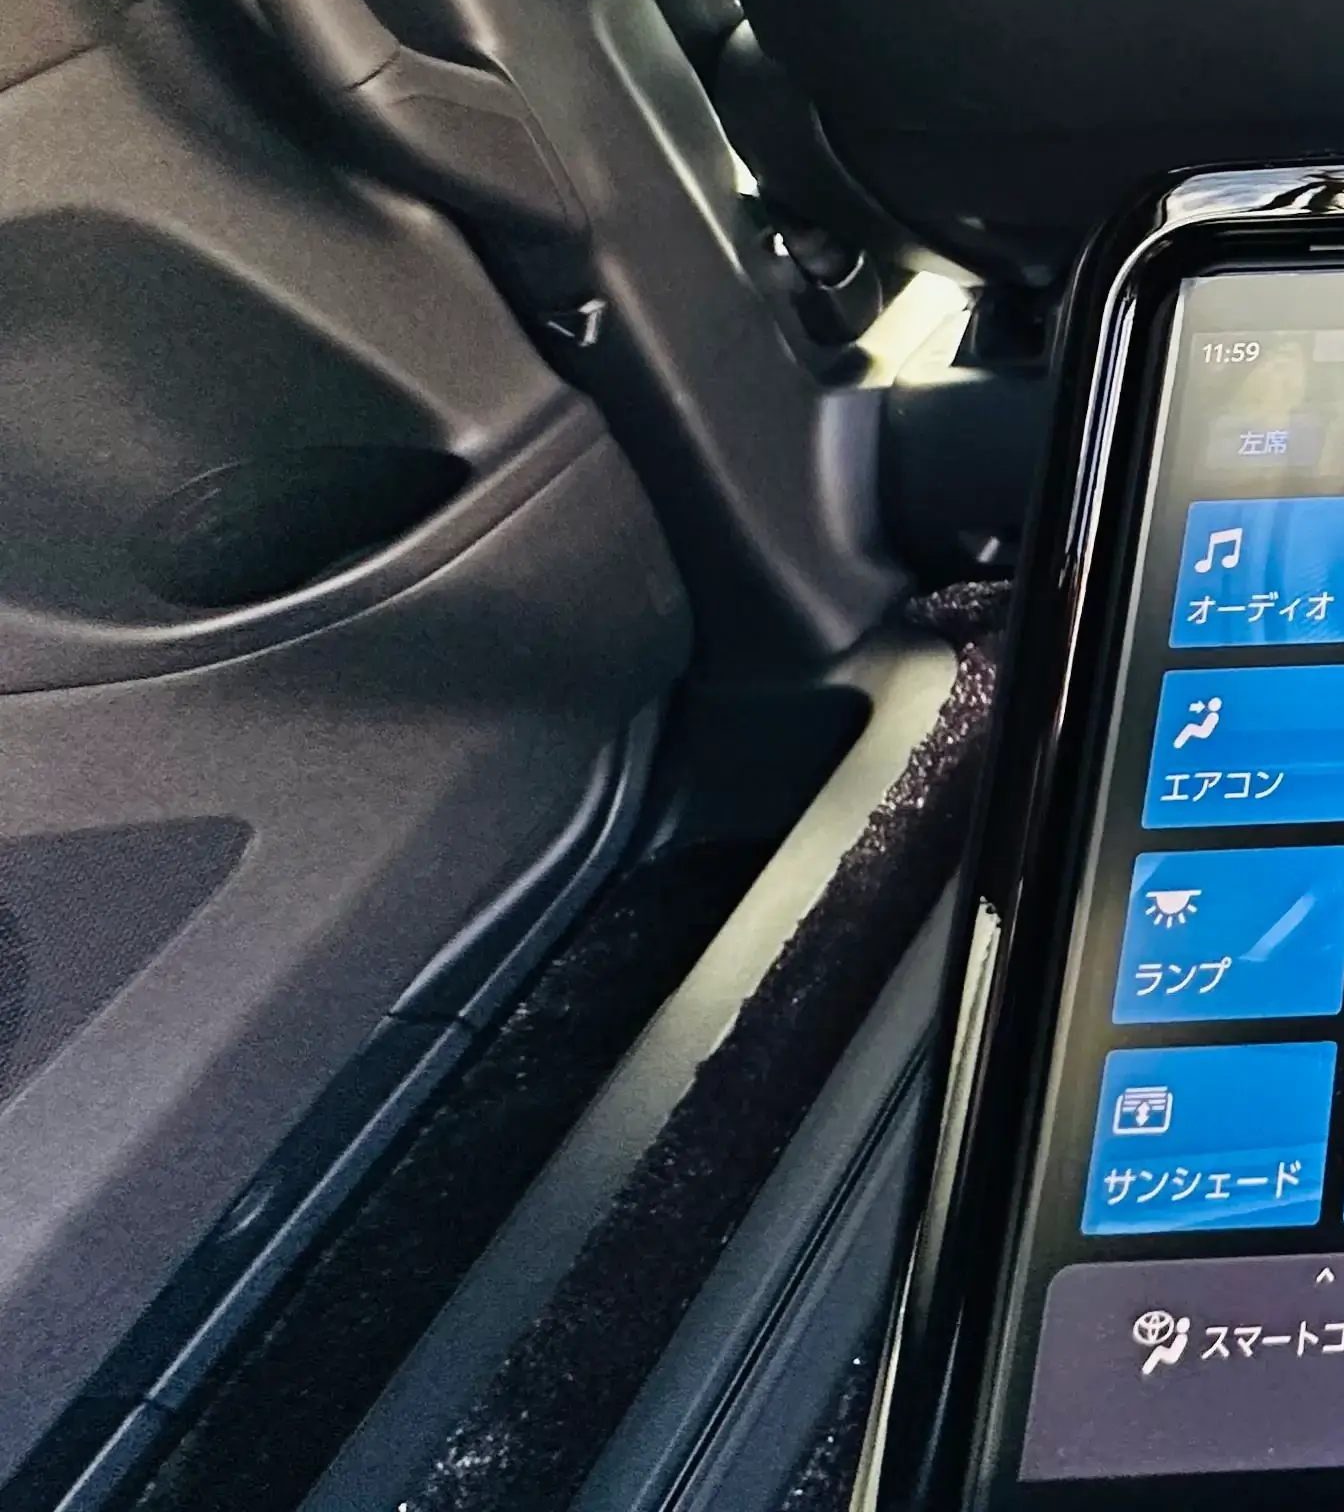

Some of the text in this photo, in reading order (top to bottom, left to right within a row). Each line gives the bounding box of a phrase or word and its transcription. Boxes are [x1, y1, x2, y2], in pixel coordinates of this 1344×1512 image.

[1201, 340, 1261, 365] 11:59
[1236, 428, 1289, 456] 左席
[1187, 590, 1335, 624] オーディオ
[1159, 769, 1285, 803] エアコン
[1134, 956, 1232, 995] ランプ
[1103, 1160, 1303, 1206] サンシェード
